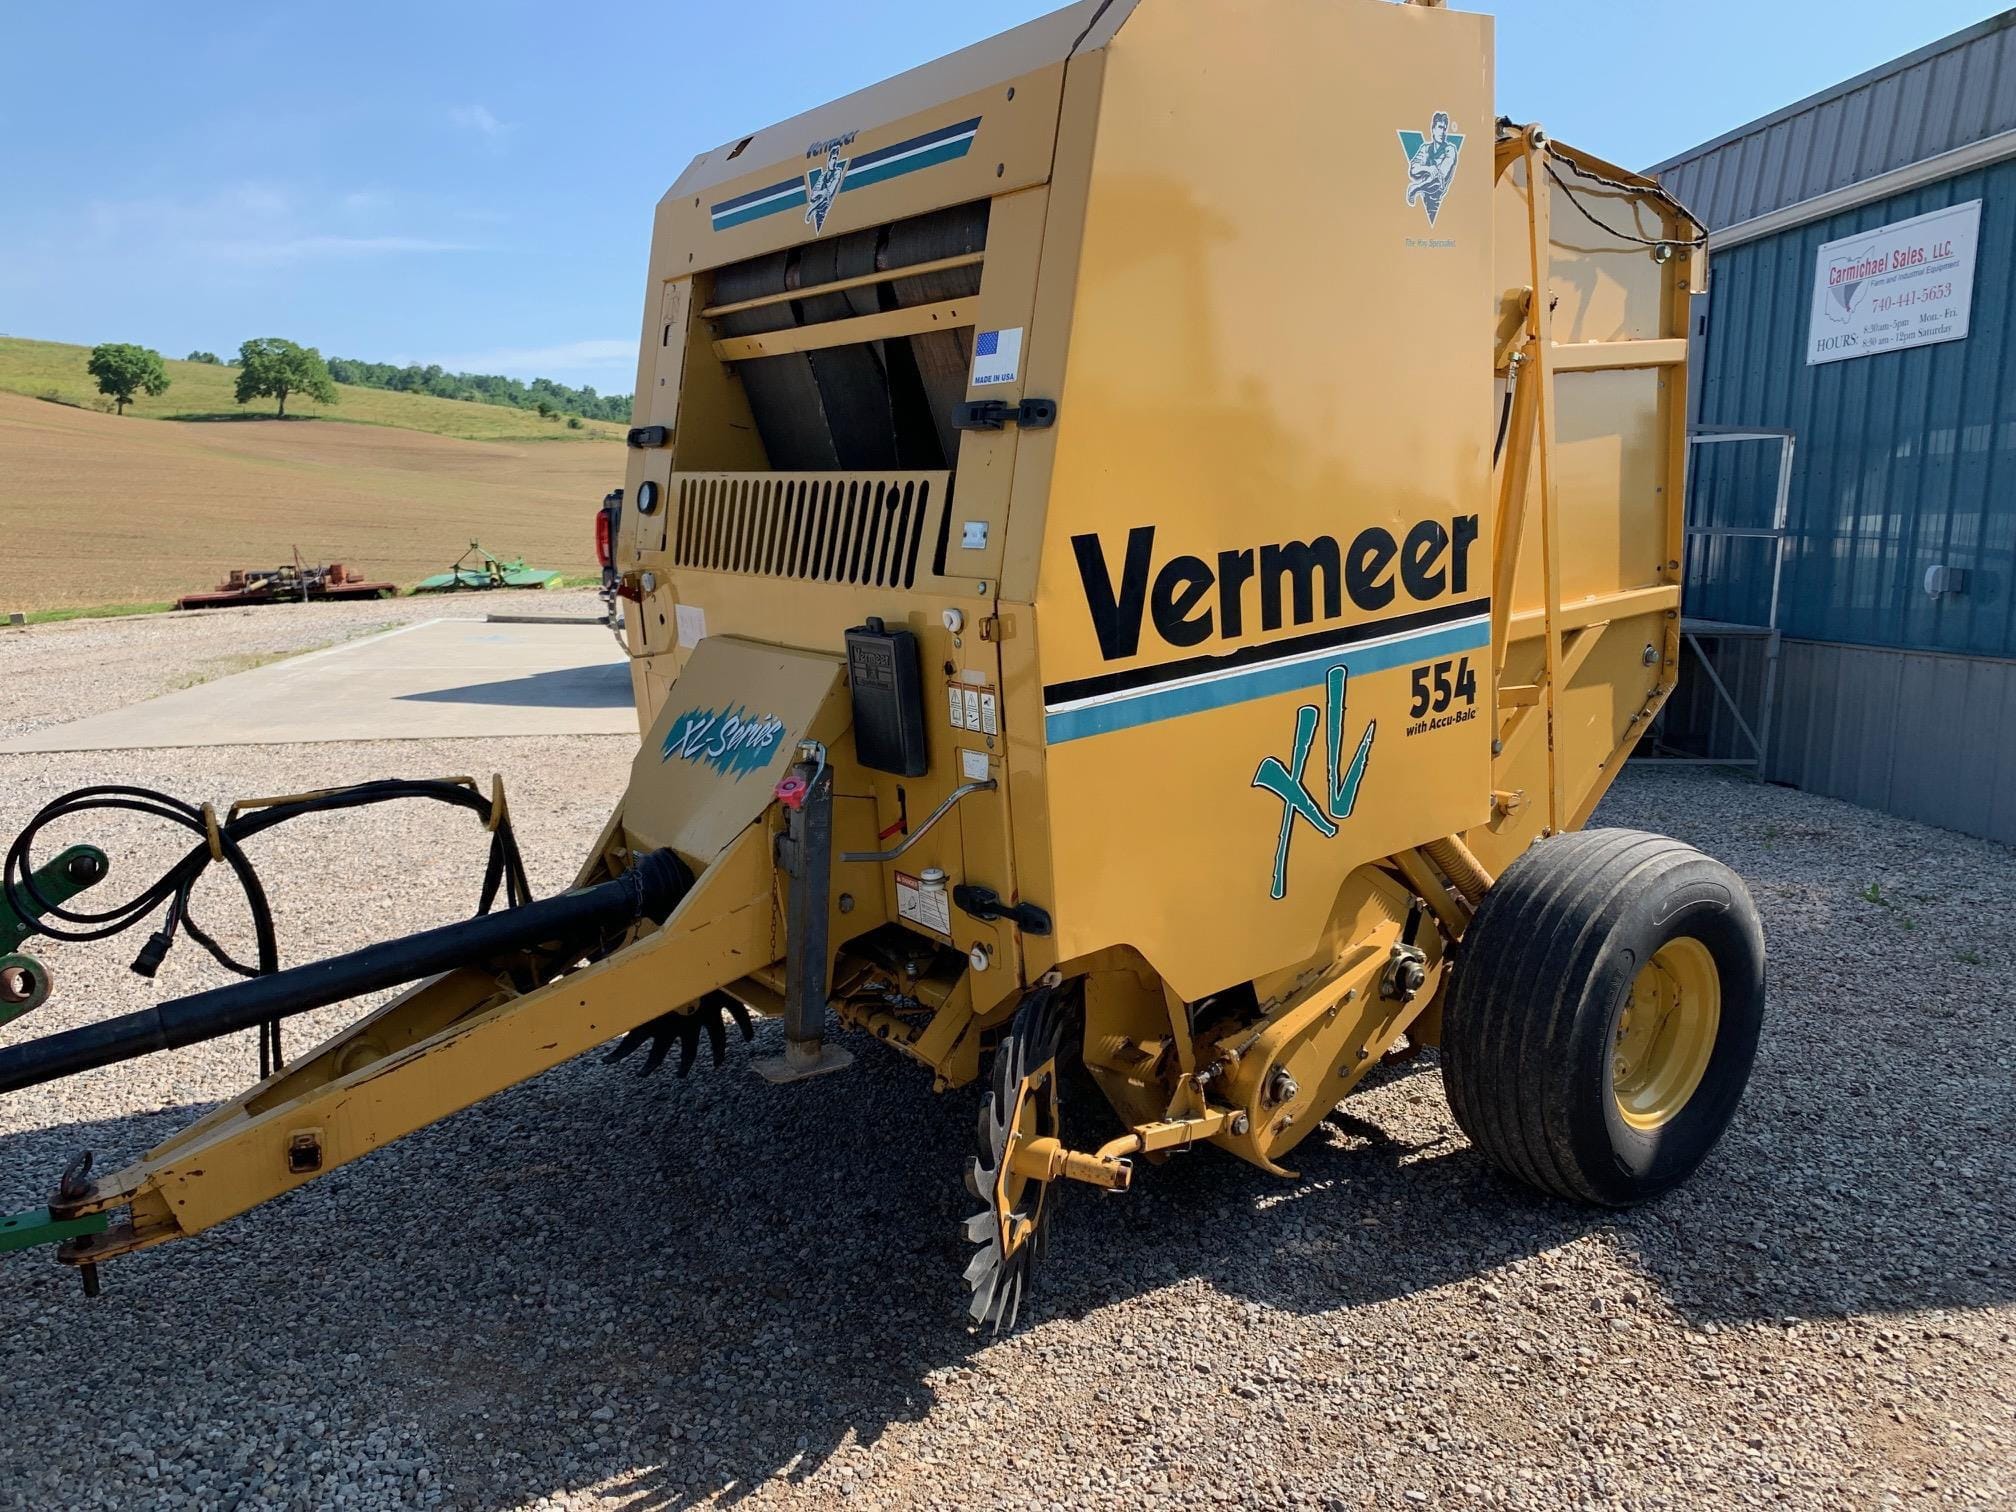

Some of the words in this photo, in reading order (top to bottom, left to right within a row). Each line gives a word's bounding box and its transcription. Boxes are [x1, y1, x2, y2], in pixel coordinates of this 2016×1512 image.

[1829, 252, 1888, 285] Carmichael
[1892, 246, 1927, 269] Sales,
[1933, 240, 1953, 259] LLC.
[1871, 279, 1886, 287] Farm
[1886, 275, 1897, 283] and
[1899, 269, 1925, 280] Industrial
[1926, 260, 1960, 275] Equipment
[1872, 282, 1952, 313] 740-441-5653
[1816, 333, 1859, 352] HOURS:
[1879, 337, 1889, 345] am
[1895, 331, 1915, 344] 12pm
[1918, 323, 1953, 338] Saturday
[975, 375, 992, 384] MADE
[993, 374, 1000, 382] IN
[1001, 373, 1014, 381] USA
[1070, 513, 1479, 661] Vermeer
[1409, 656, 1476, 719] 554
[1406, 721, 1427, 737] with
[1429, 707, 1476, 731] Accu-Bale
